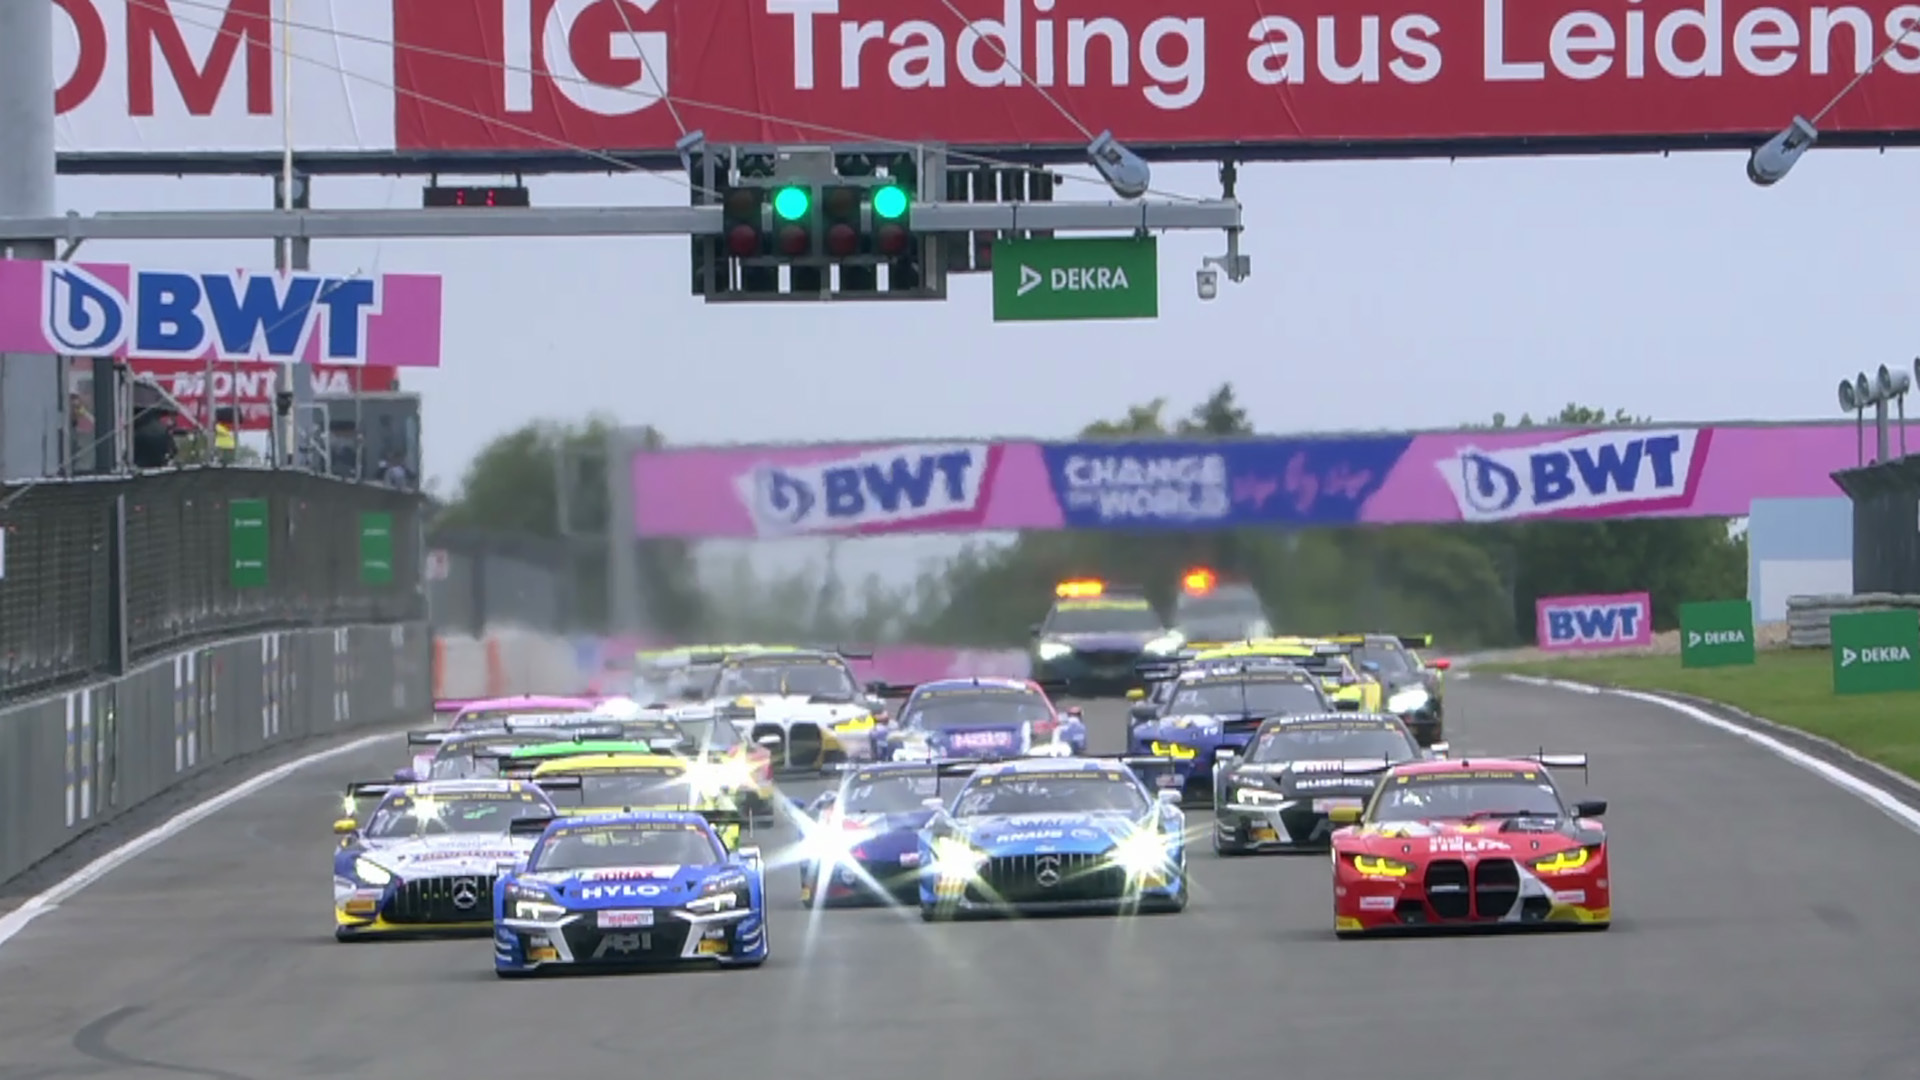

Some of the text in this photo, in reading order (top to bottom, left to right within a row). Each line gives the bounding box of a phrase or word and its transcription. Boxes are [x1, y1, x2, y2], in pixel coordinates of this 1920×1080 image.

[502, 0, 668, 116] IG
[766, 0, 1206, 109] Trading
[1246, 8, 1442, 84] aus
[1051, 266, 1129, 291] DEKRA
[136, 271, 374, 358] BWT
[823, 449, 972, 518] BWT
[1530, 435, 1680, 503] BWT
[1548, 603, 1643, 641] BWT
[1704, 629, 1745, 645] DEKRA
[1862, 646, 1911, 664] DEKRA
[581, 884, 661, 900] HYLO
